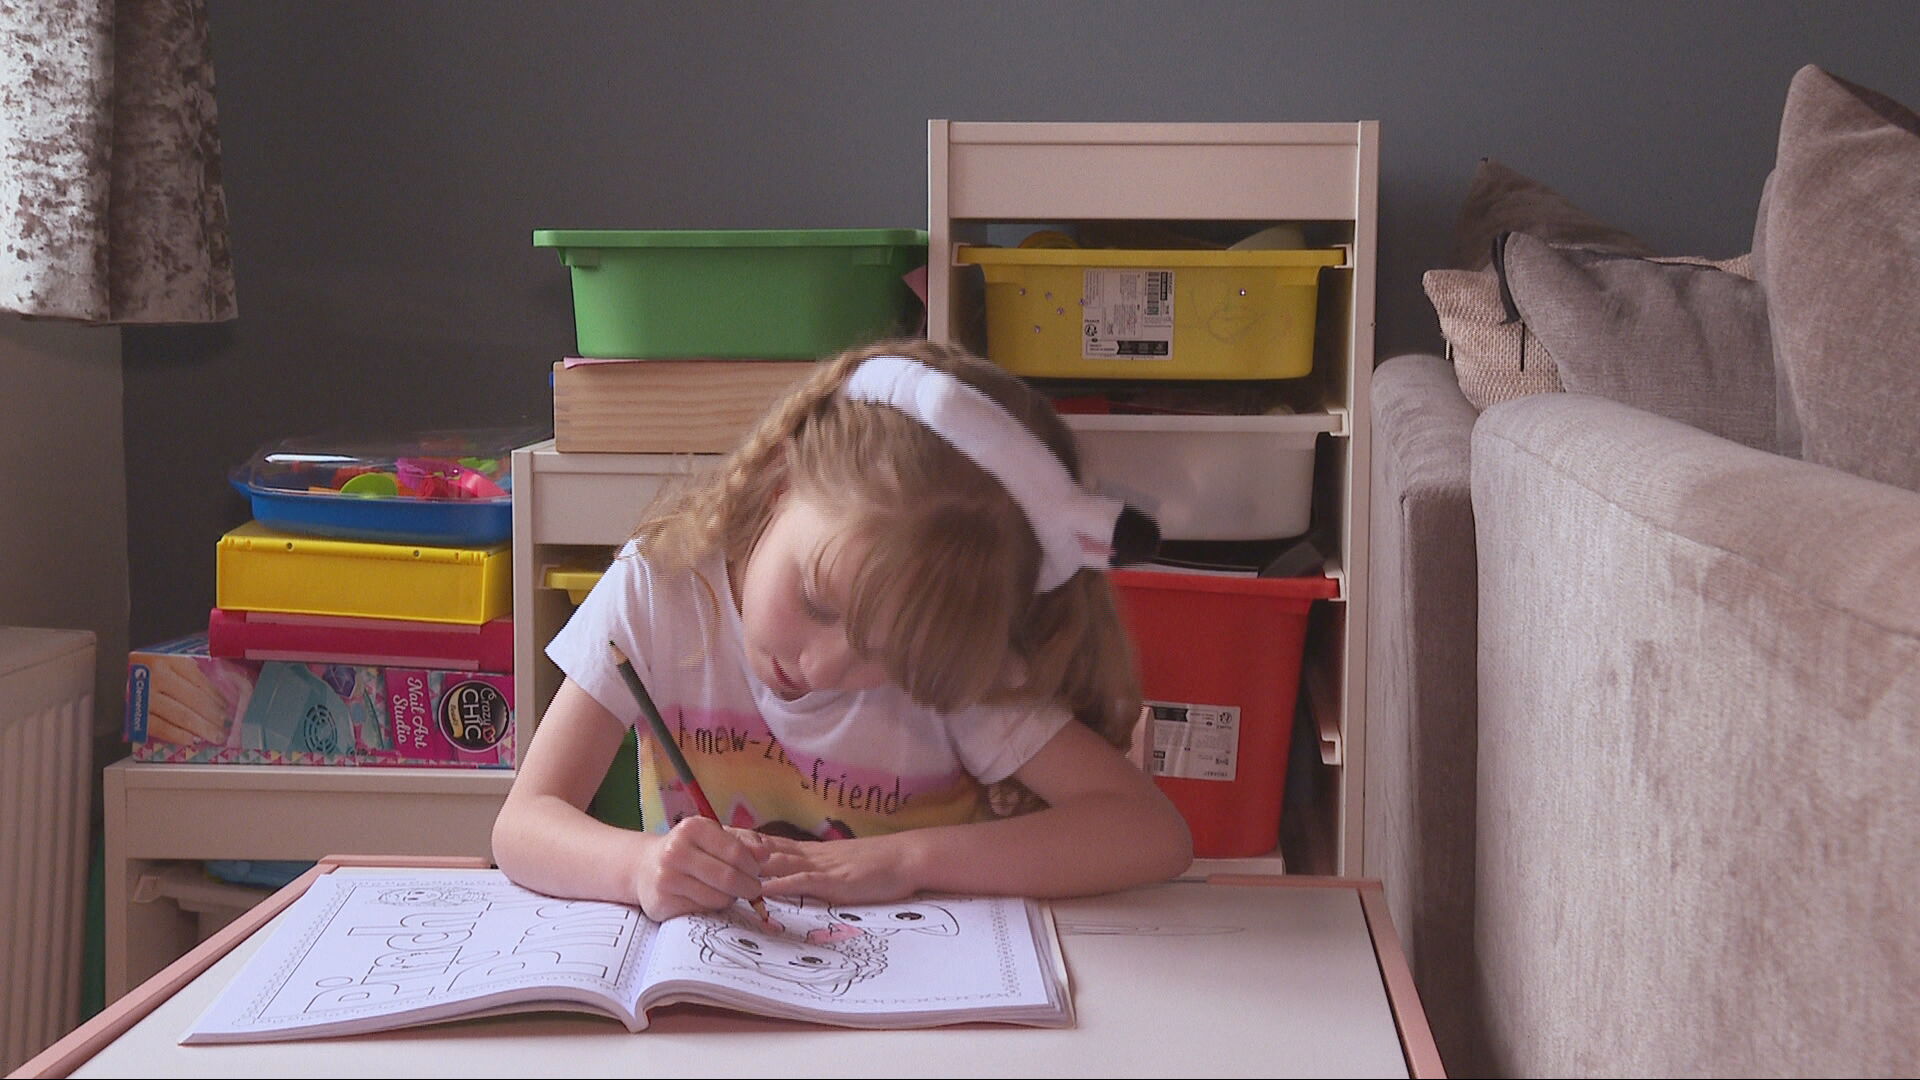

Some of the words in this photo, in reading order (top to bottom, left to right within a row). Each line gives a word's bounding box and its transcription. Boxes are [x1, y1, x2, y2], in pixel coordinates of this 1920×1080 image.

[134, 680, 145, 732] Clementoni
[407, 676, 426, 714] Nail
[480, 687, 497, 727] Crazy
[393, 695, 411, 745] Studio
[412, 714, 429, 749] Art
